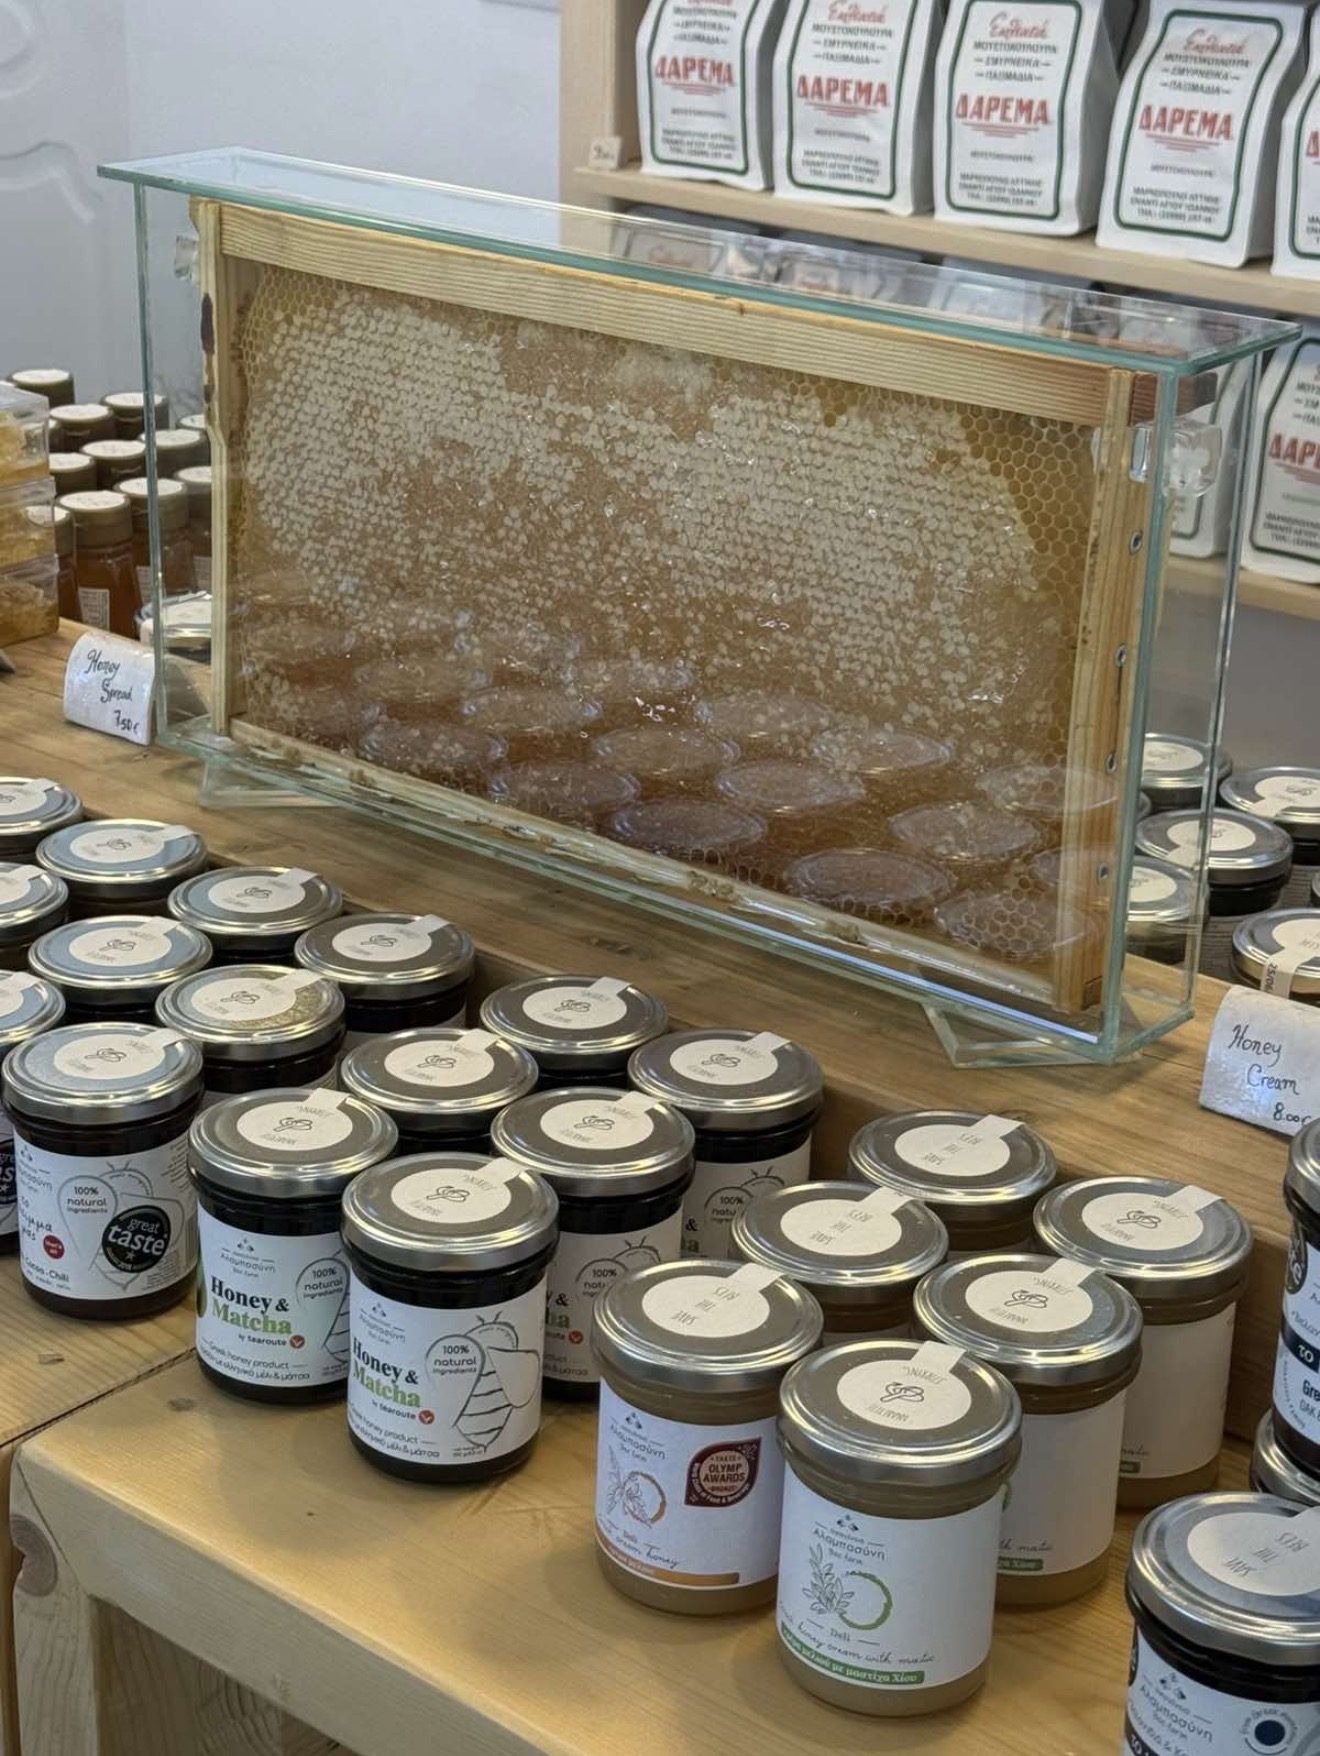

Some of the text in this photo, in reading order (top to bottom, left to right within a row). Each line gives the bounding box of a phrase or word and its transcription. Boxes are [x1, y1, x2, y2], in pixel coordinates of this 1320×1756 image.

[655, 56, 734, 87] ΔΑΡΕΜΑ
[797, 75, 887, 107] ΔΑΡΕΜΑ
[955, 92, 1049, 125] ΔΑΡΕΜΑ
[1139, 104, 1233, 140] ΔΑΡΕΜΑ
[84, 649, 120, 680] Honey
[1228, 1023, 1281, 1068] Honey
[1247, 1063, 1299, 1095] Cream
[74, 1186, 99, 1196] 100%
[67, 1198, 107, 1207] natural
[719, 1195, 743, 1205] 100%
[712, 1208, 736, 1217] natu
[127, 1219, 160, 1235] great
[108, 1224, 165, 1256] taste
[312, 1268, 337, 1278] 100%
[592, 1268, 617, 1278] 100%
[304, 1278, 343, 1291] natural
[211, 1275, 289, 1314] Honey &
[556, 1293, 568, 1307] &
[212, 1296, 292, 1335] Matcha
[247, 1334, 287, 1346] tearoute
[443, 1344, 469, 1354] 100%
[252, 1359, 290, 1370] product
[353, 1337, 402, 1383] Honey
[405, 1369, 419, 1385] &
[434, 1356, 476, 1366] natural
[353, 1359, 421, 1408] Matcha
[1302, 1379, 1320, 1403] Gre
[379, 1402, 416, 1420] tearoute
[383, 1430, 418, 1444] product
[708, 1463, 742, 1473] OLYMP
[703, 1473, 746, 1482] AWARDS
[830, 1628, 850, 1642] Deli
